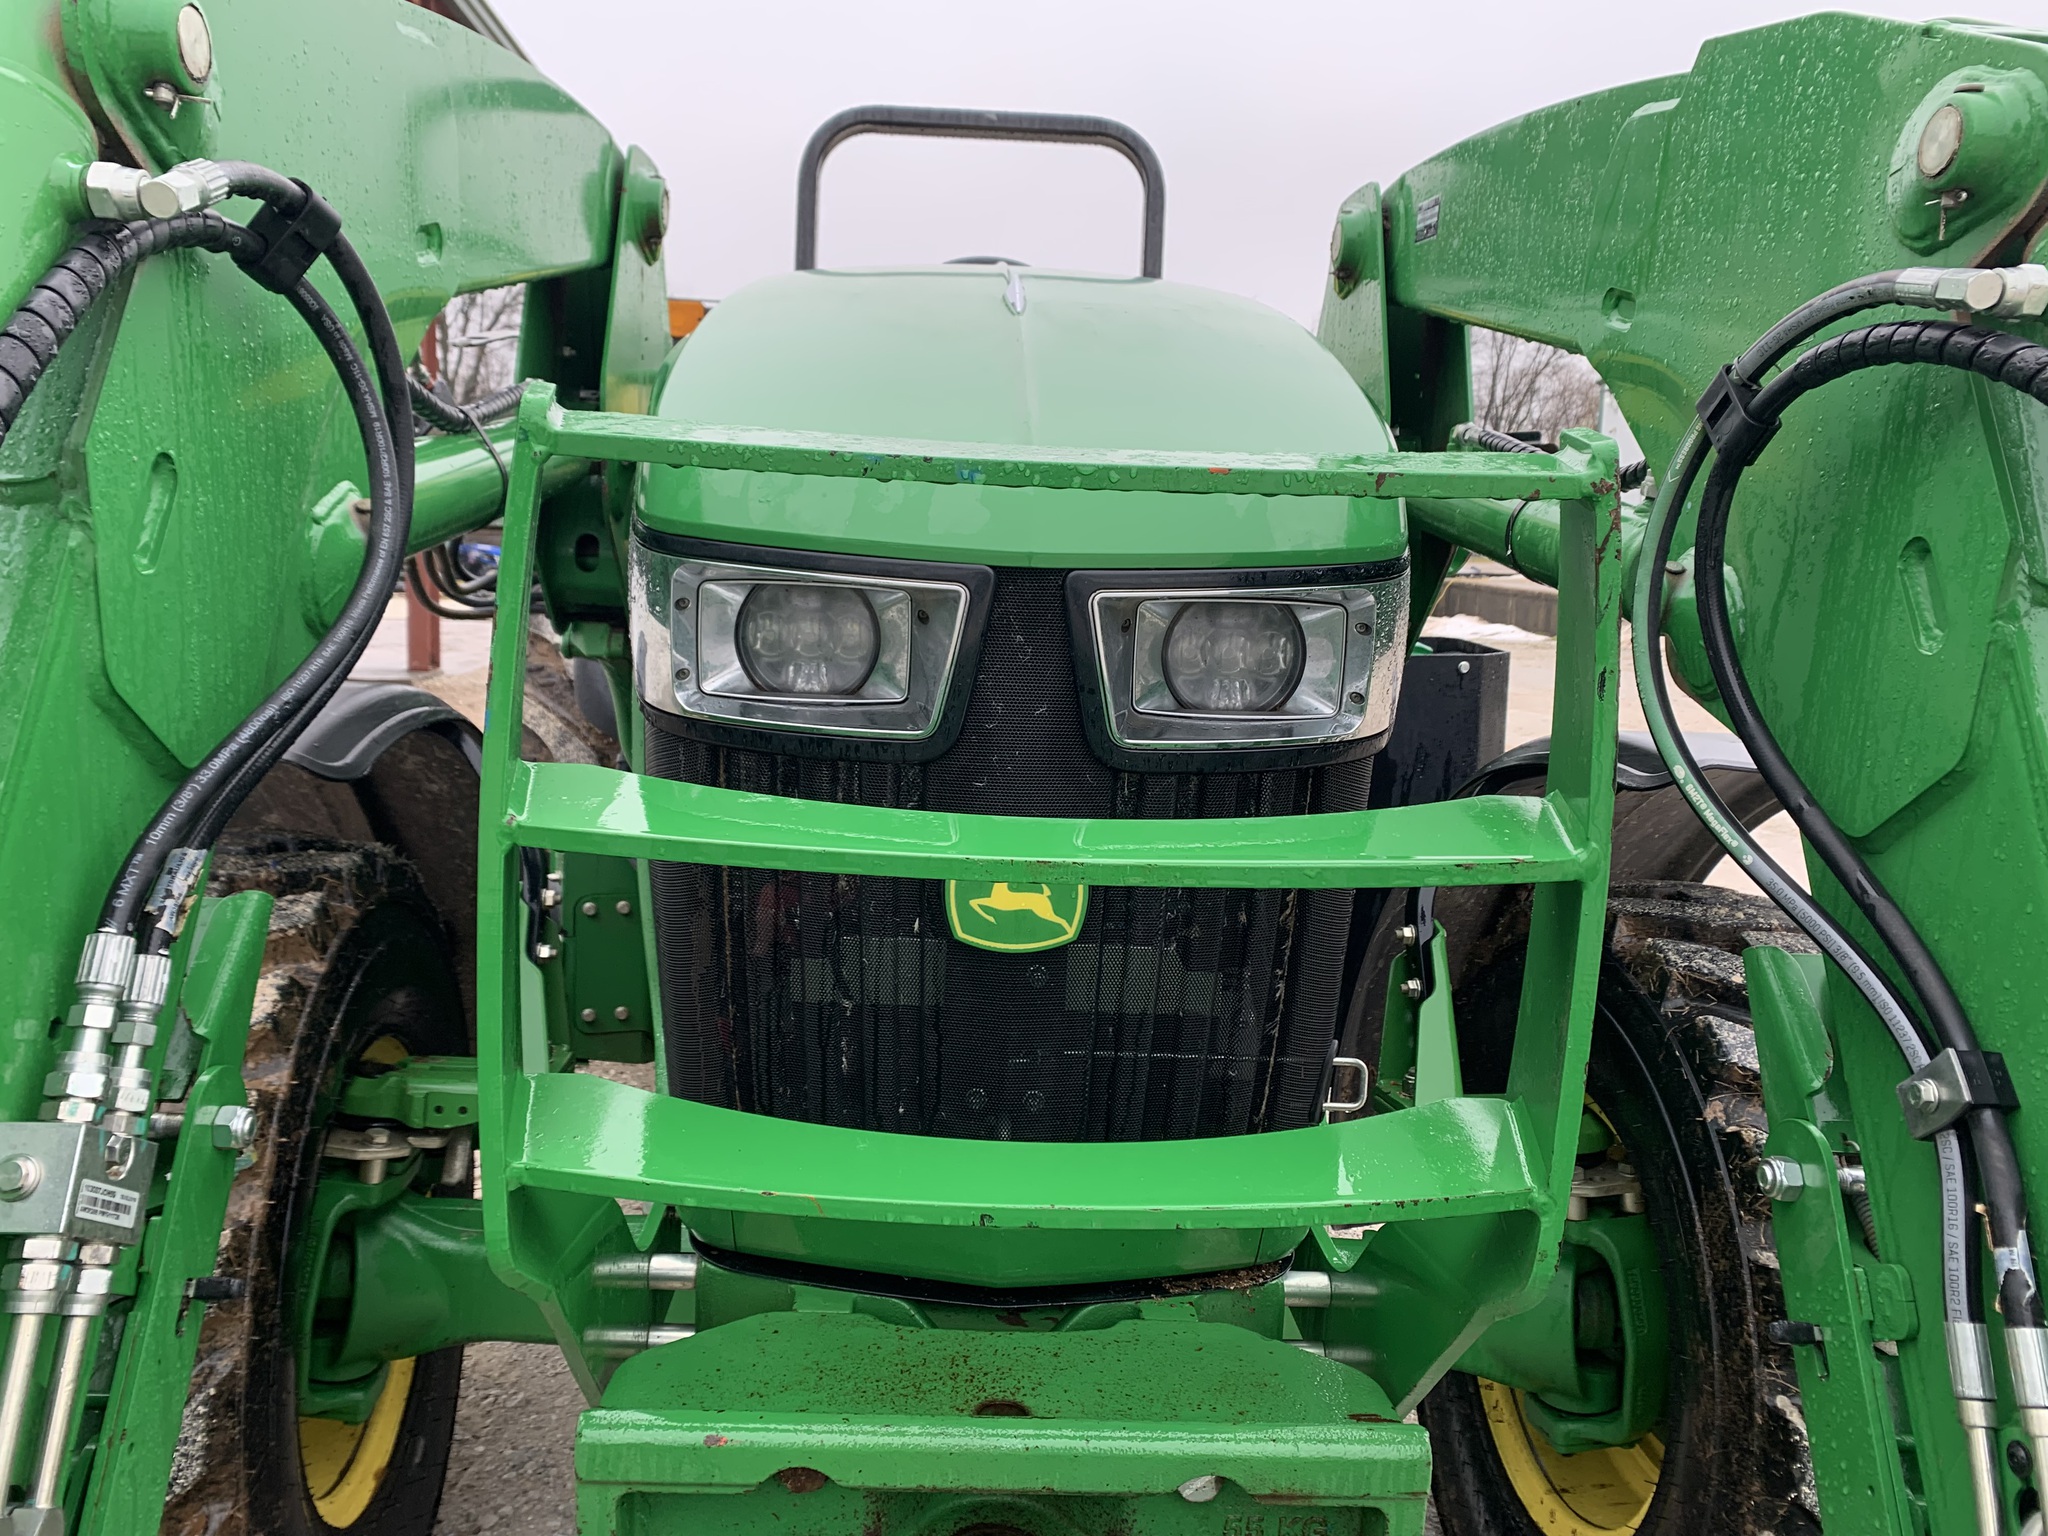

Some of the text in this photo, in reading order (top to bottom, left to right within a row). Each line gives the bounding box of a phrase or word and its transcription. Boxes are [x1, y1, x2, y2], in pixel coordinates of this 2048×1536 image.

[321, 313, 335, 332] USA
[1783, 316, 1805, 336] MSHA
[333, 331, 341, 339] in
[1756, 332, 1783, 358] 2G-11C
[338, 339, 354, 361] Made
[350, 362, 369, 393] 2G-11C
[363, 395, 378, 418] MSHA
[383, 506, 392, 523] 2SC
[380, 537, 388, 549] EN
[361, 559, 385, 599] Performance
[293, 670, 311, 689] 11237
[280, 687, 296, 701] ISO
[195, 743, 239, 784] 33.0MPa
[172, 783, 201, 813] (3/8")
[145, 812, 176, 846] 10mm
[167, 852, 188, 888] YDRAULICS
[112, 898, 125, 908] 6
[1765, 877, 1785, 896] 35.0
[1782, 893, 1799, 911] MPa
[1796, 908, 1821, 932] (5000
[1819, 929, 1837, 949] PSI)
[1833, 944, 1853, 962] 3/8"
[1862, 979, 1883, 1002] mm)
[1879, 998, 1894, 1016] ISO
[1888, 1014, 1912, 1045] 11237
[1905, 1043, 1923, 1064] 2SC
[1939, 1131, 1953, 1154] 2SC
[1944, 1163, 1957, 1185] SAE
[1946, 1186, 1959, 1231] 100R16
[1948, 1241, 1960, 1264] SAE
[1948, 1265, 1961, 1307] 100R2
